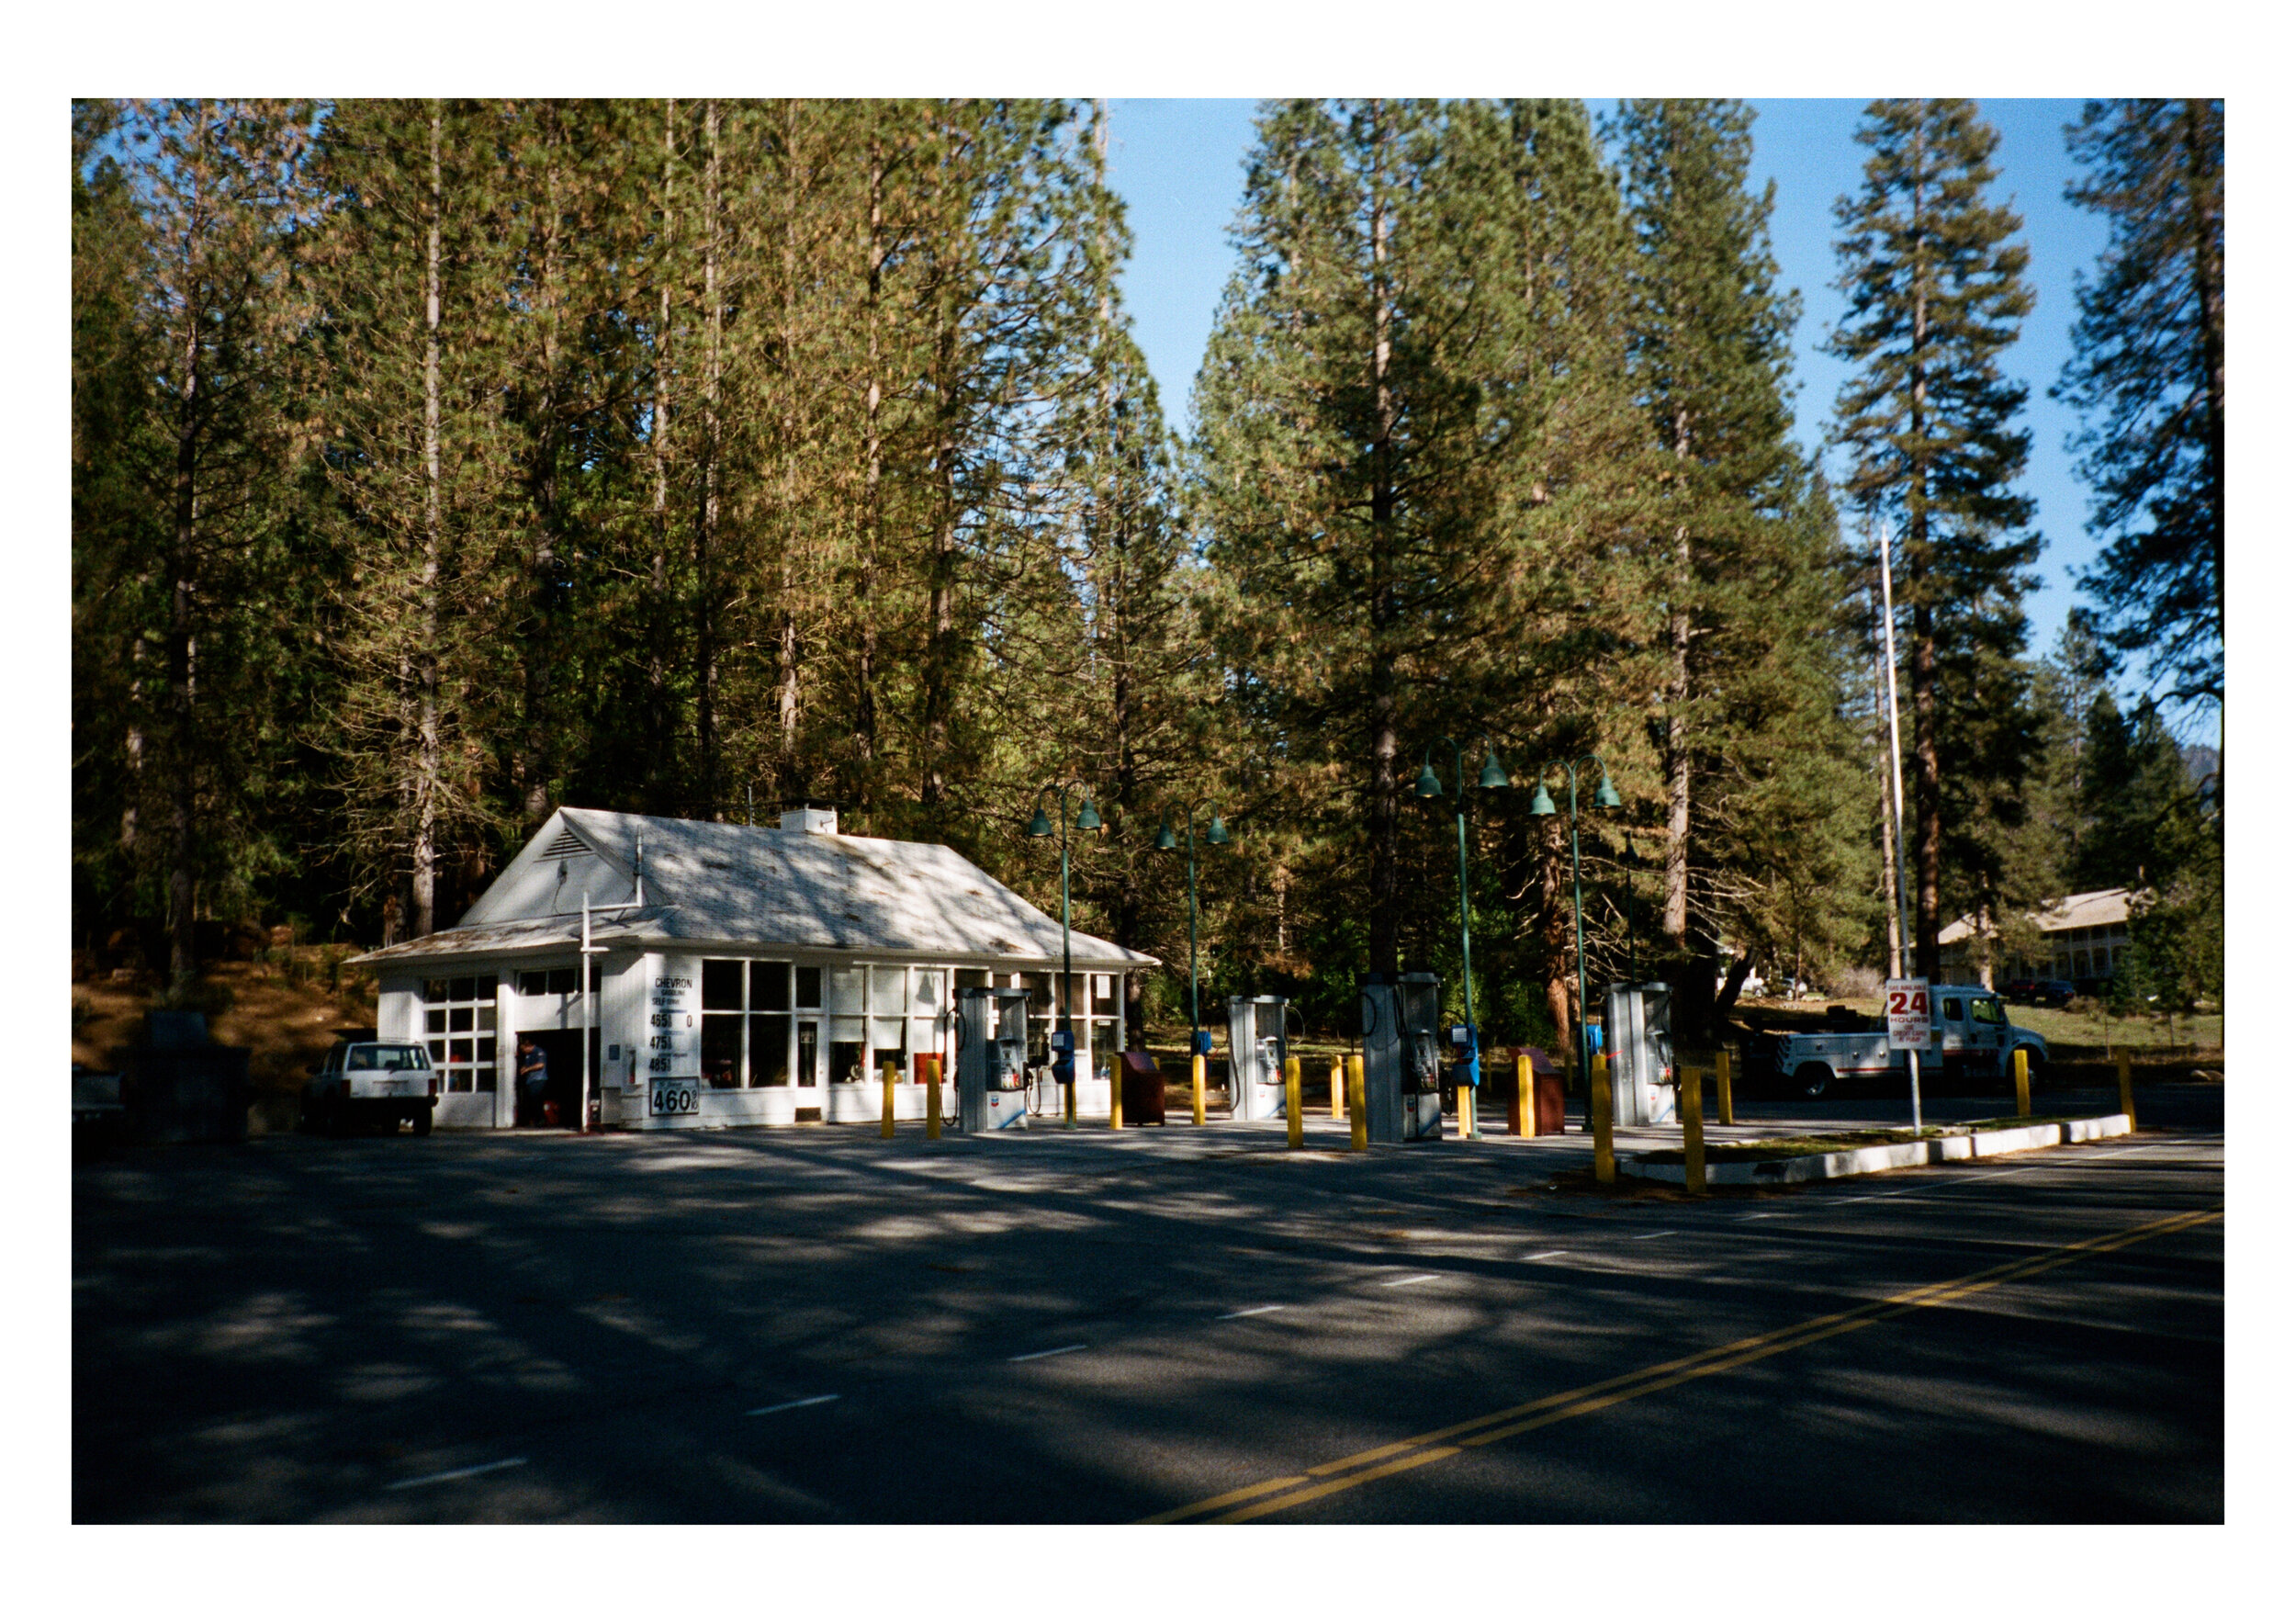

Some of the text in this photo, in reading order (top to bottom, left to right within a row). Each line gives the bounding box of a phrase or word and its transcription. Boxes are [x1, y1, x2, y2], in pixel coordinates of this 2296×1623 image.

[655, 977, 692, 988] CHEVRON
[652, 997, 666, 1006] SELF
[1889, 992, 1928, 1014] 24
[650, 1036, 667, 1050] 475
[649, 1058, 667, 1072] 485
[654, 1089, 691, 1111] 460
